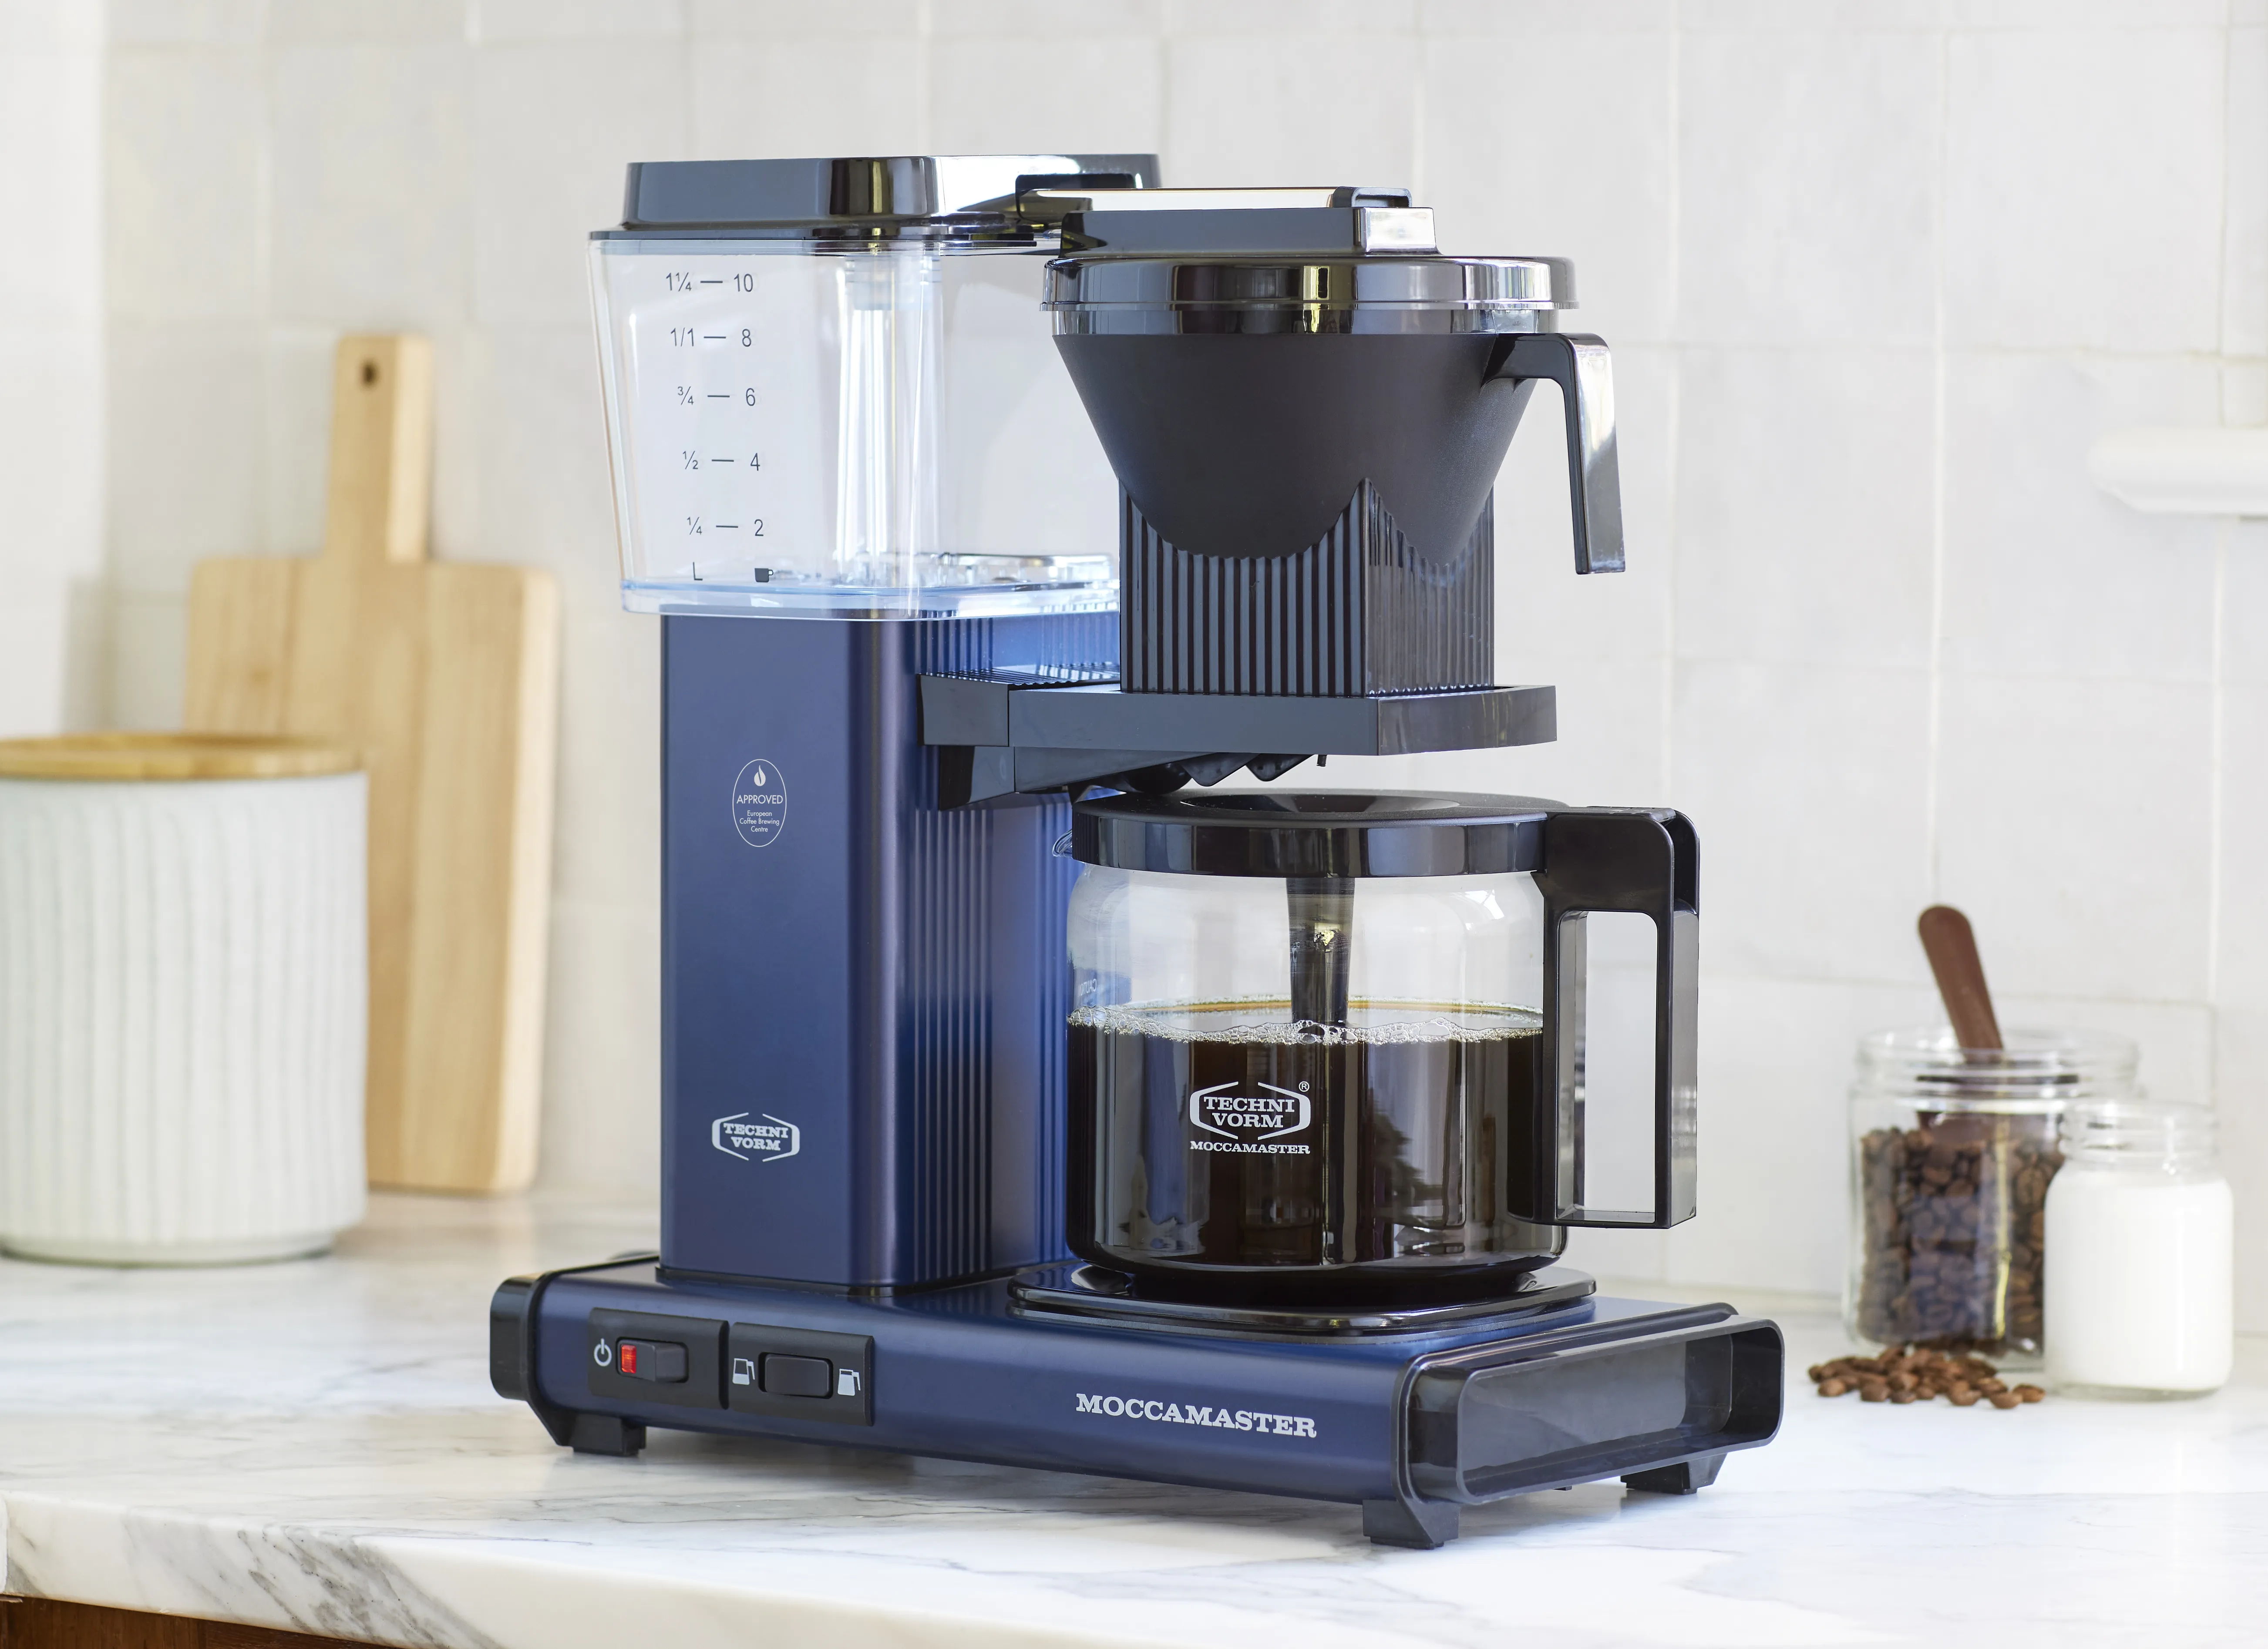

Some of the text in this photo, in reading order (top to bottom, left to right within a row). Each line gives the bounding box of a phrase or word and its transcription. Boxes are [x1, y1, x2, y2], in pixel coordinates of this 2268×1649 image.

[734, 273, 753, 292] 10
[670, 328, 752, 347] 1/1 8
[745, 387, 756, 406] 6
[750, 452, 761, 471] 4
[754, 518, 764, 537] 2
[693, 561, 703, 581] L
[736, 795, 783, 804] APPROVED
[747, 810, 772, 818] European
[1203, 1096, 1295, 1112] TECHNI
[1211, 1112, 1284, 1128] VORM
[723, 1122, 789, 1139] TECHNI
[730, 1136, 781, 1151] VORM
[1189, 1140, 1311, 1155] MOCCAMASTER
[1076, 1393, 1317, 1438] MOCCAMASTER
